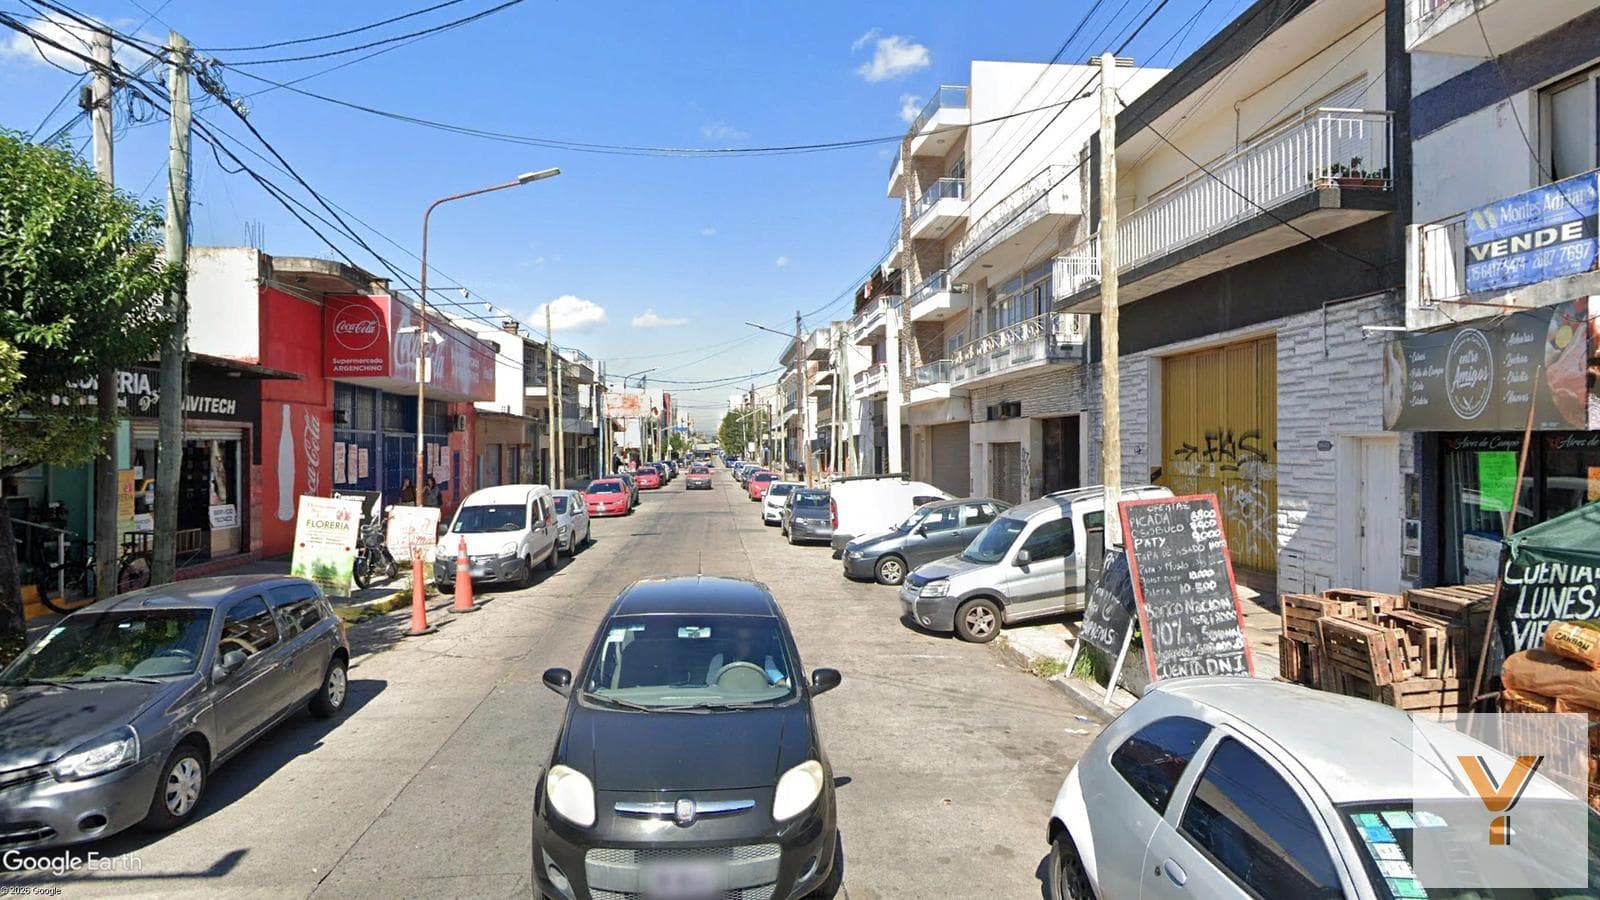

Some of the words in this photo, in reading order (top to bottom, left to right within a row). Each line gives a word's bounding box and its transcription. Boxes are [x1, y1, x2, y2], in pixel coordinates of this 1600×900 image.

[1500, 201, 1541, 225] Montes
[1471, 221, 1583, 261] VENDE
[336, 320, 376, 334] Coca-Cola
[1459, 352, 1479, 364] entre
[1451, 365, 1489, 392] Amigos
[1456, 436, 1478, 449] Aires
[1479, 438, 1489, 448] de
[1489, 435, 1520, 451] Campo
[1557, 434, 1586, 449] Aires
[306, 520, 349, 530] FLORERIA
[1130, 513, 1170, 528] PICADA
[1134, 537, 1166, 550] PATY
[1515, 584, 1597, 619] LUNES
[1206, 655, 1246, 676] DNI
